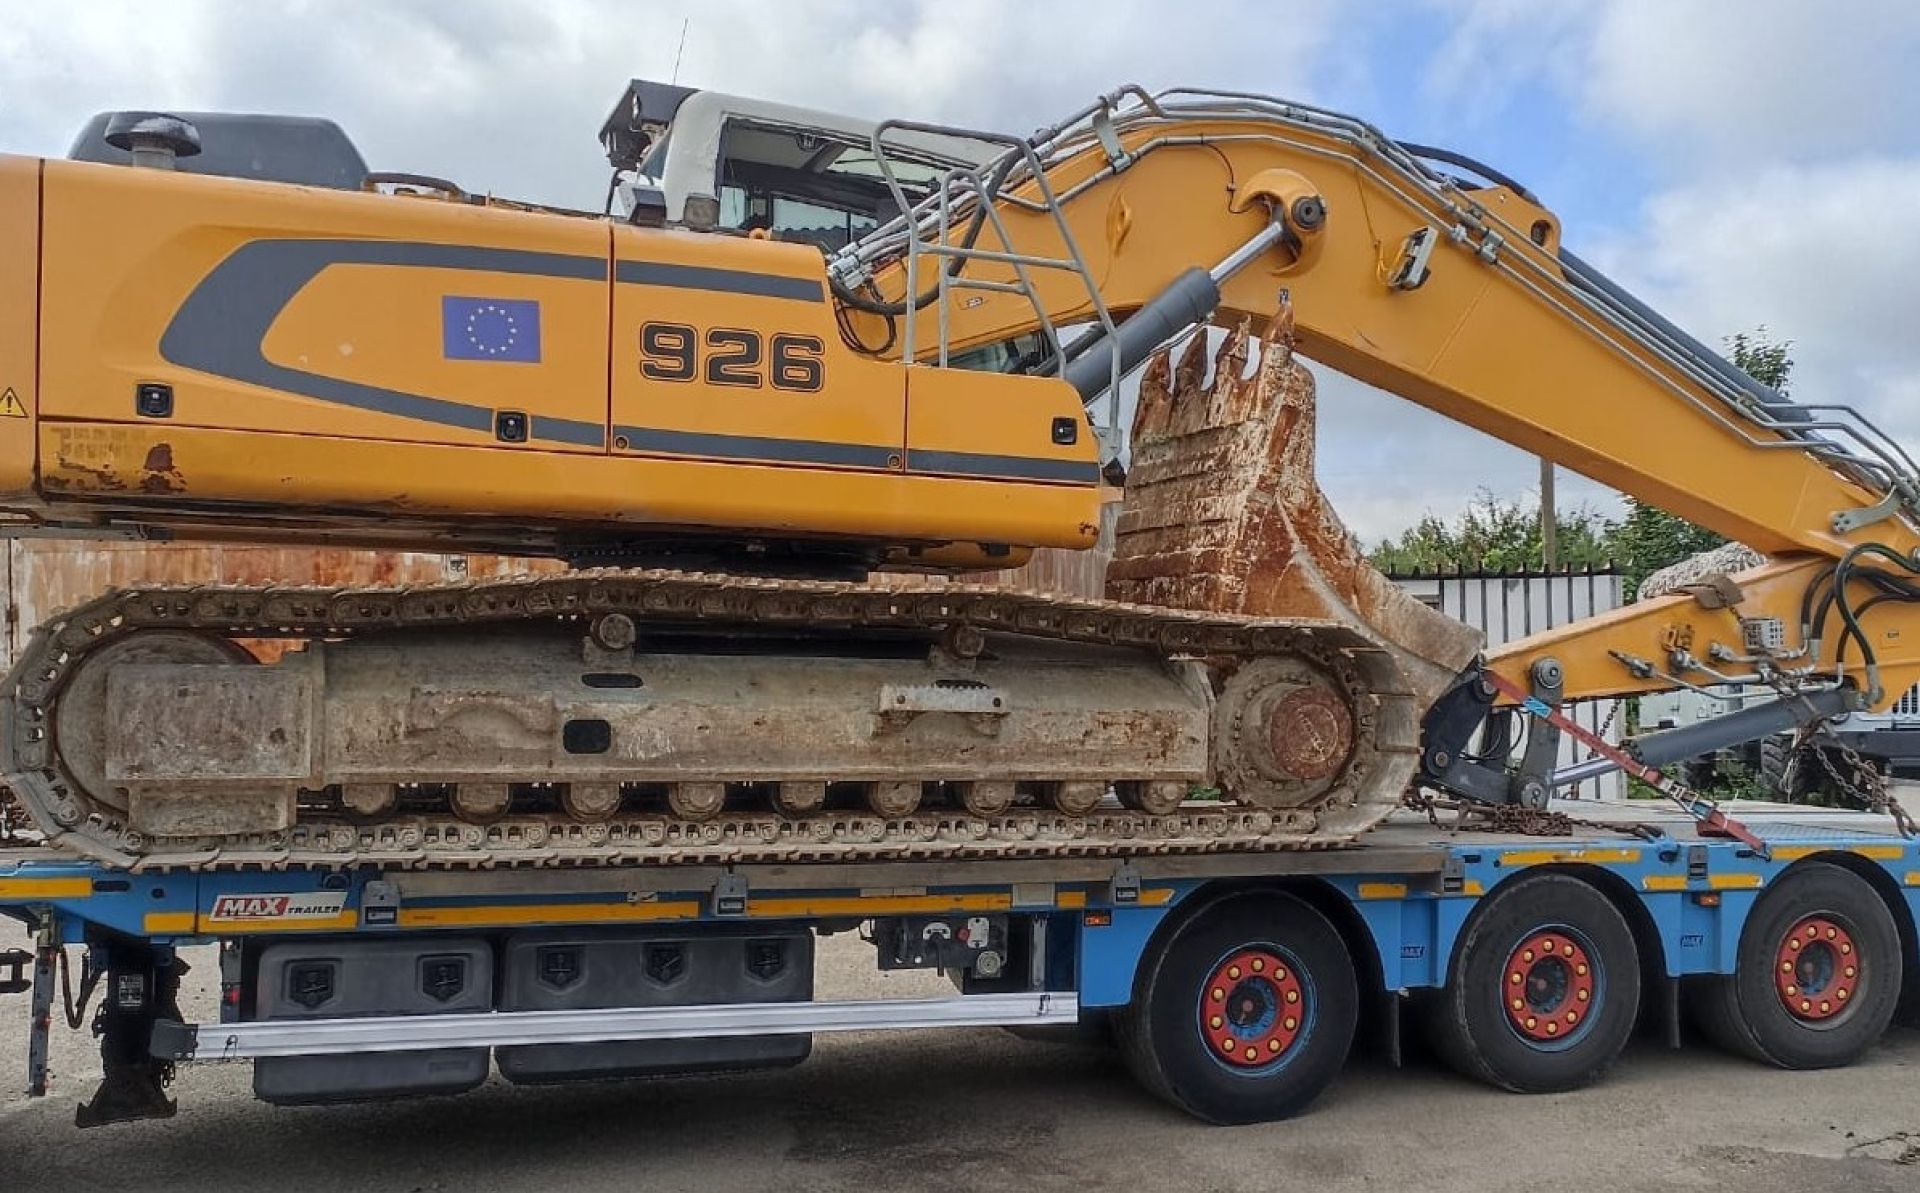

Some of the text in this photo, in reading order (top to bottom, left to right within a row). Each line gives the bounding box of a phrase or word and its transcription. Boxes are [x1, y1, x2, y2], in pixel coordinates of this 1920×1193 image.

[640, 321, 825, 393] 926
[222, 898, 340, 916] MAX TRAILER
